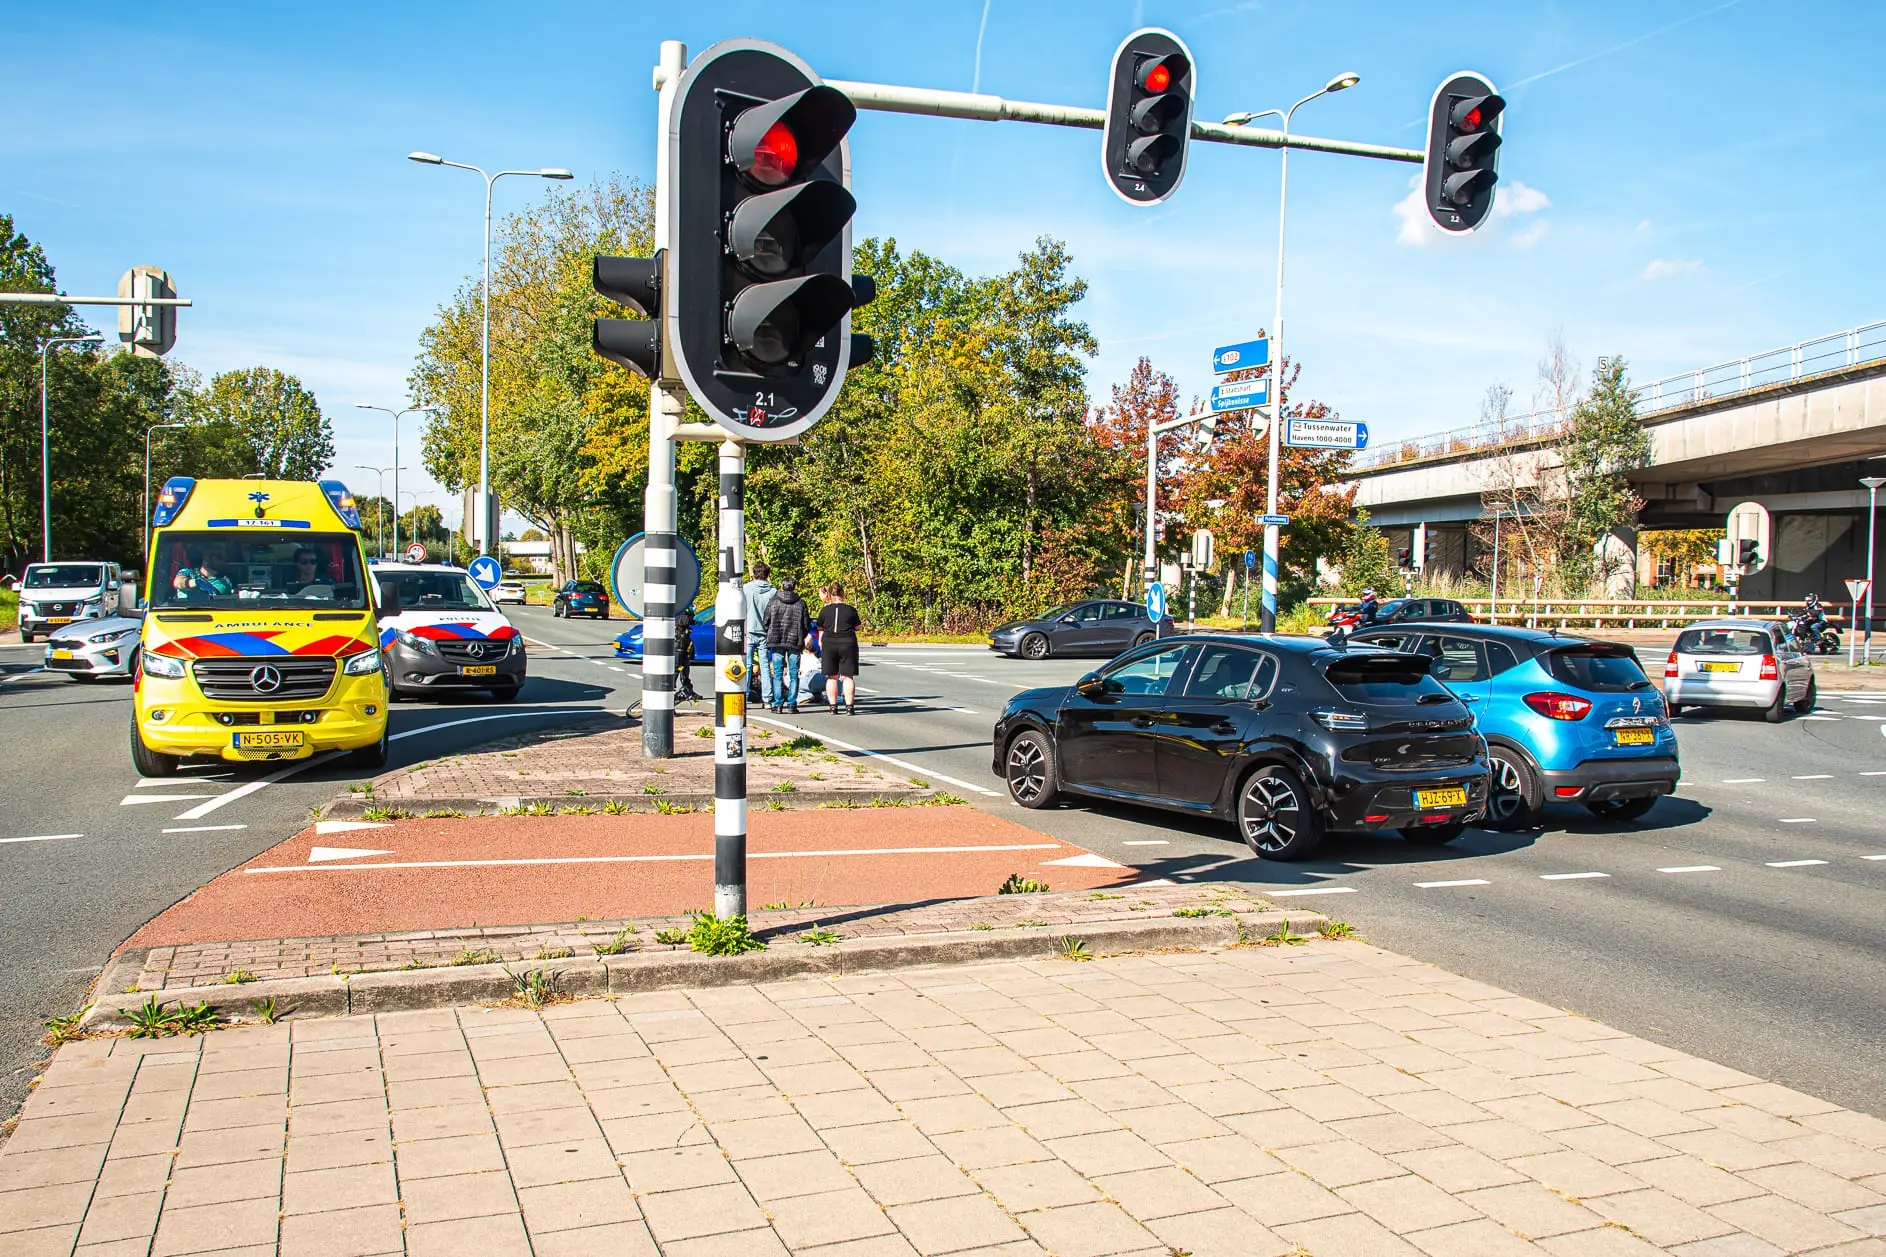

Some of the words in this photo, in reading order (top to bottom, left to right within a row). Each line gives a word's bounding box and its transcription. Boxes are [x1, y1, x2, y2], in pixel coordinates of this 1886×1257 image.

[755, 391, 774, 407] 2.1
[1303, 422, 1352, 433] Tussenwater
[1292, 434, 1315, 442] Havens
[1316, 435, 1352, 444] 1000-4000
[214, 621, 313, 629] AMBULANCE
[243, 733, 300, 745] N-505-VK
[1422, 789, 1463, 805] HJZ-69-X
